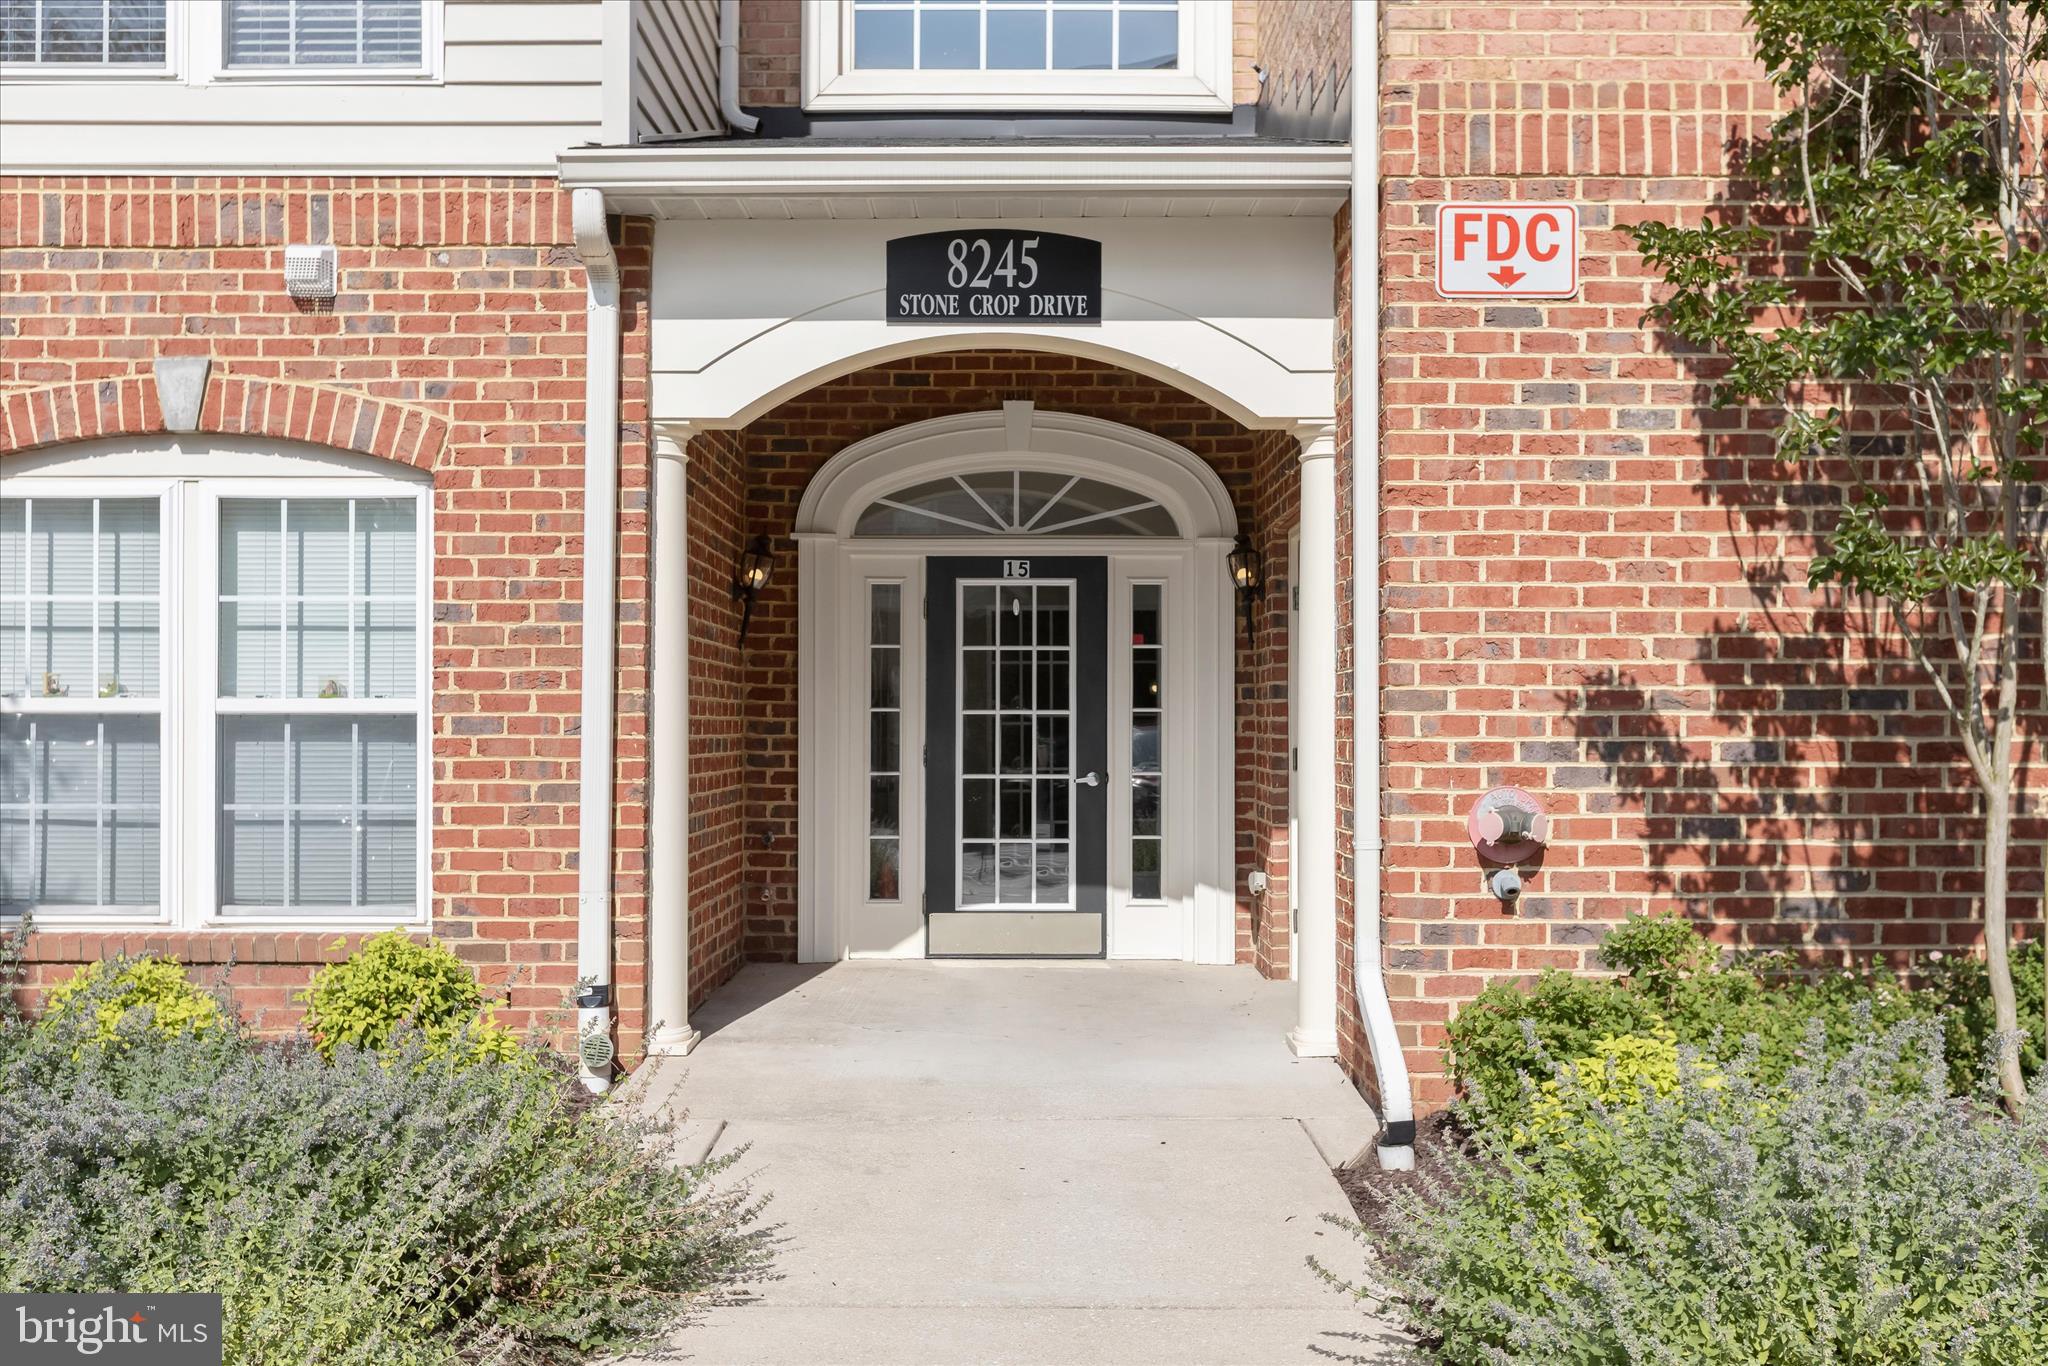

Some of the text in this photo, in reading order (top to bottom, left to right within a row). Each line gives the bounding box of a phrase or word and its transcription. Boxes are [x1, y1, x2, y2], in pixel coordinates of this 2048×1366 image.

[1454, 213, 1560, 262] FDC
[947, 236, 1040, 289] 8245
[899, 293, 1088, 316] STONE CROP DRIVE
[1007, 561, 1028, 577] 15
